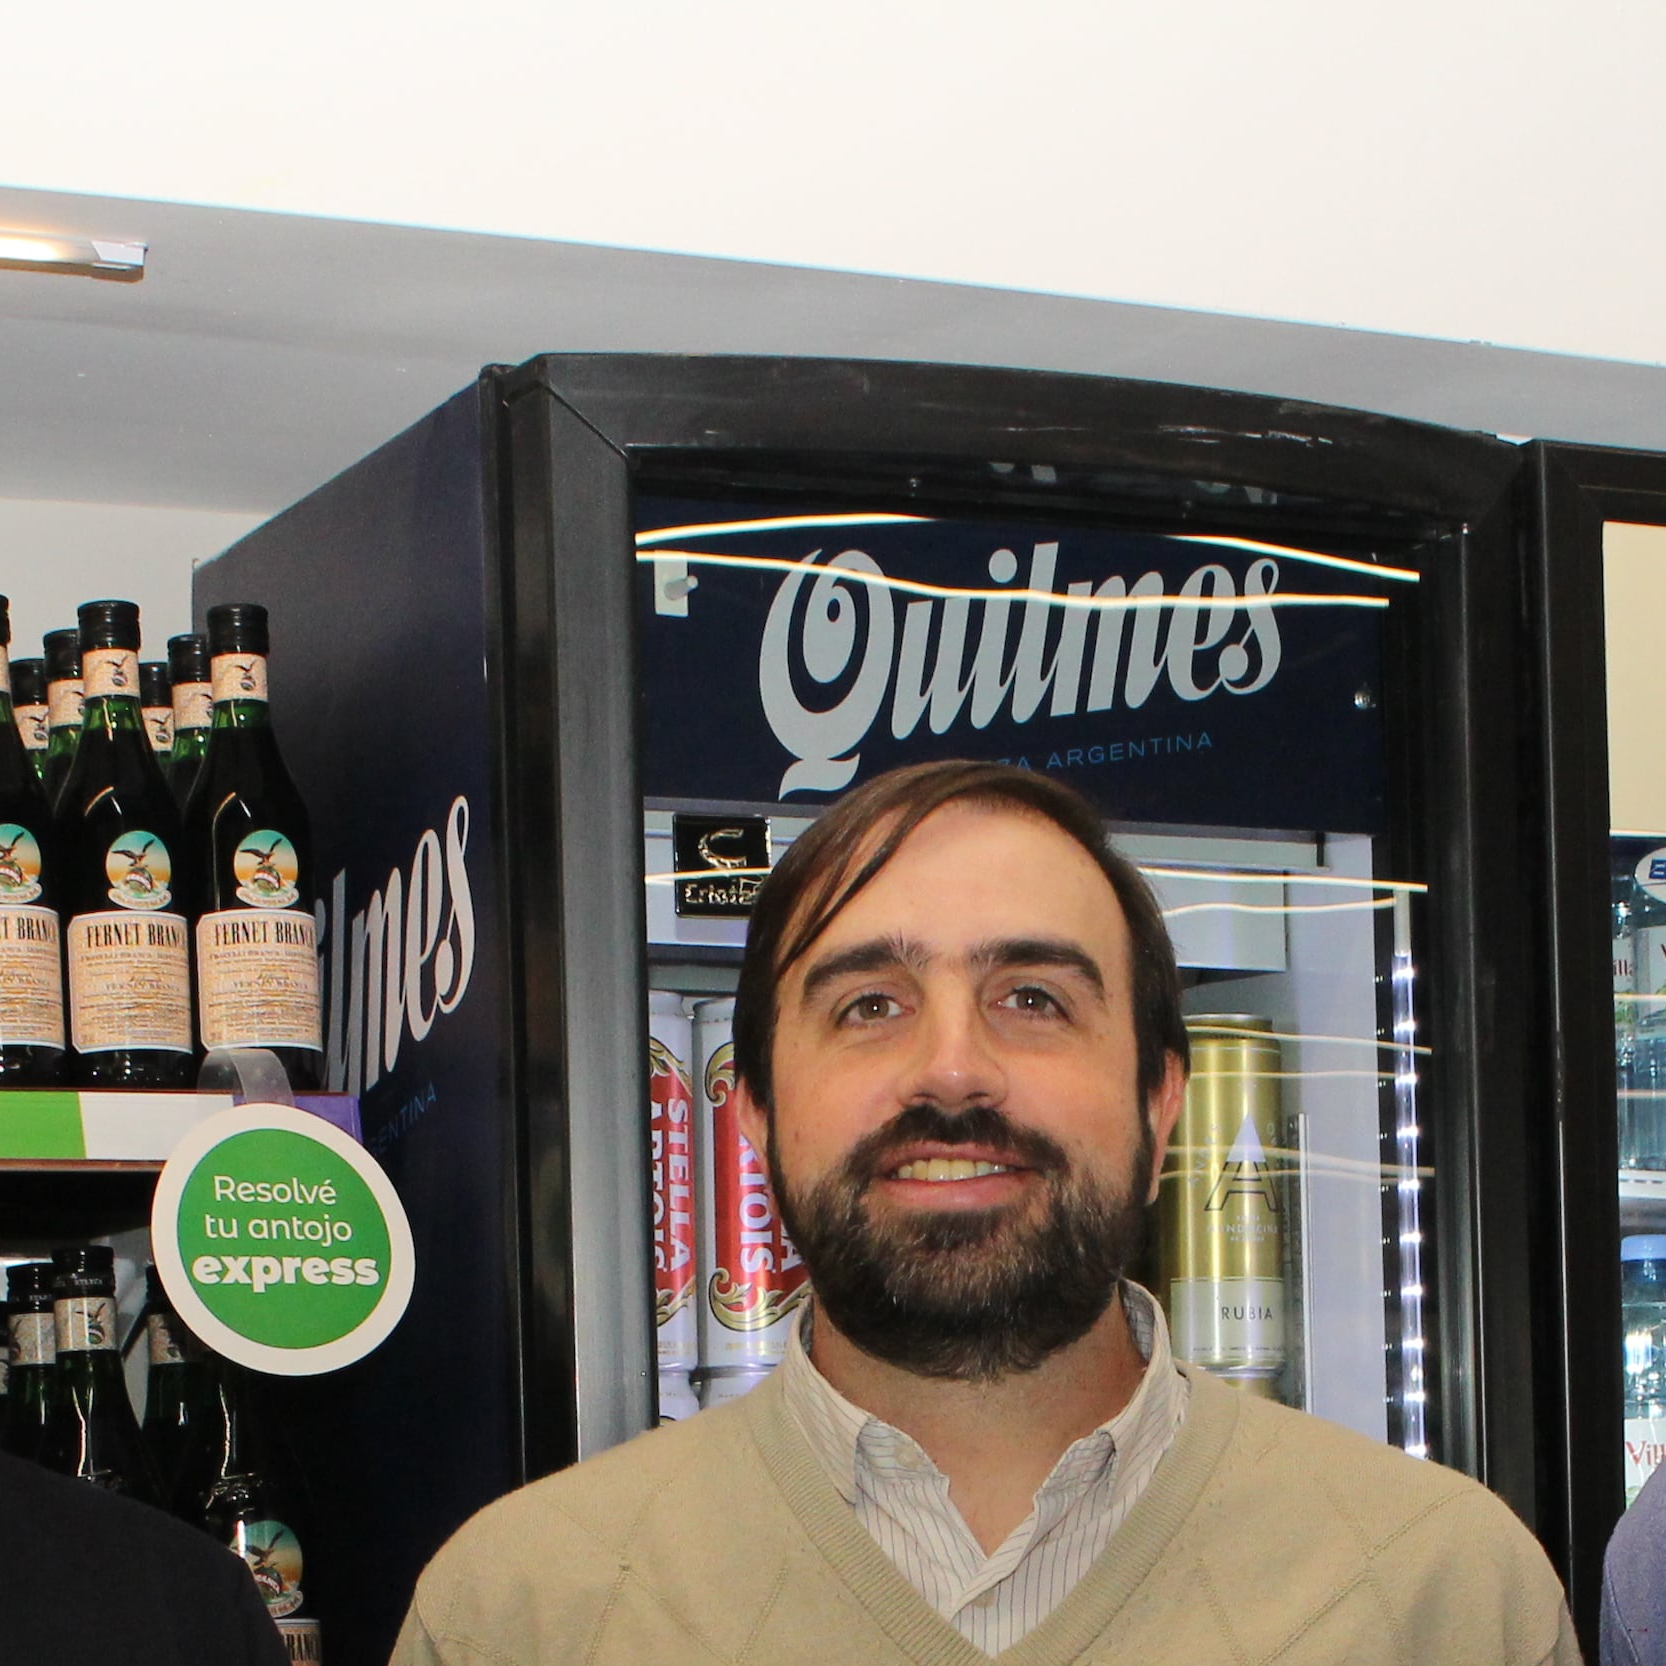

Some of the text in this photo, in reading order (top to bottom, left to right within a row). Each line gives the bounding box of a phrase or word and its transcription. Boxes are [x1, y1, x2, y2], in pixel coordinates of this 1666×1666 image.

[759, 542, 1282, 800] Quilmes
[1046, 732, 1213, 769] ARGENTINA
[87, 923, 141, 949] FERNET
[215, 922, 268, 947] FERNET
[213, 1175, 337, 1206] Resolvé
[667, 1097, 692, 1272] STELLA
[739, 1128, 774, 1275] RTOIS
[205, 1214, 353, 1248] tu antojo
[192, 1254, 380, 1293] express
[1221, 1305, 1274, 1322] RUBIA
